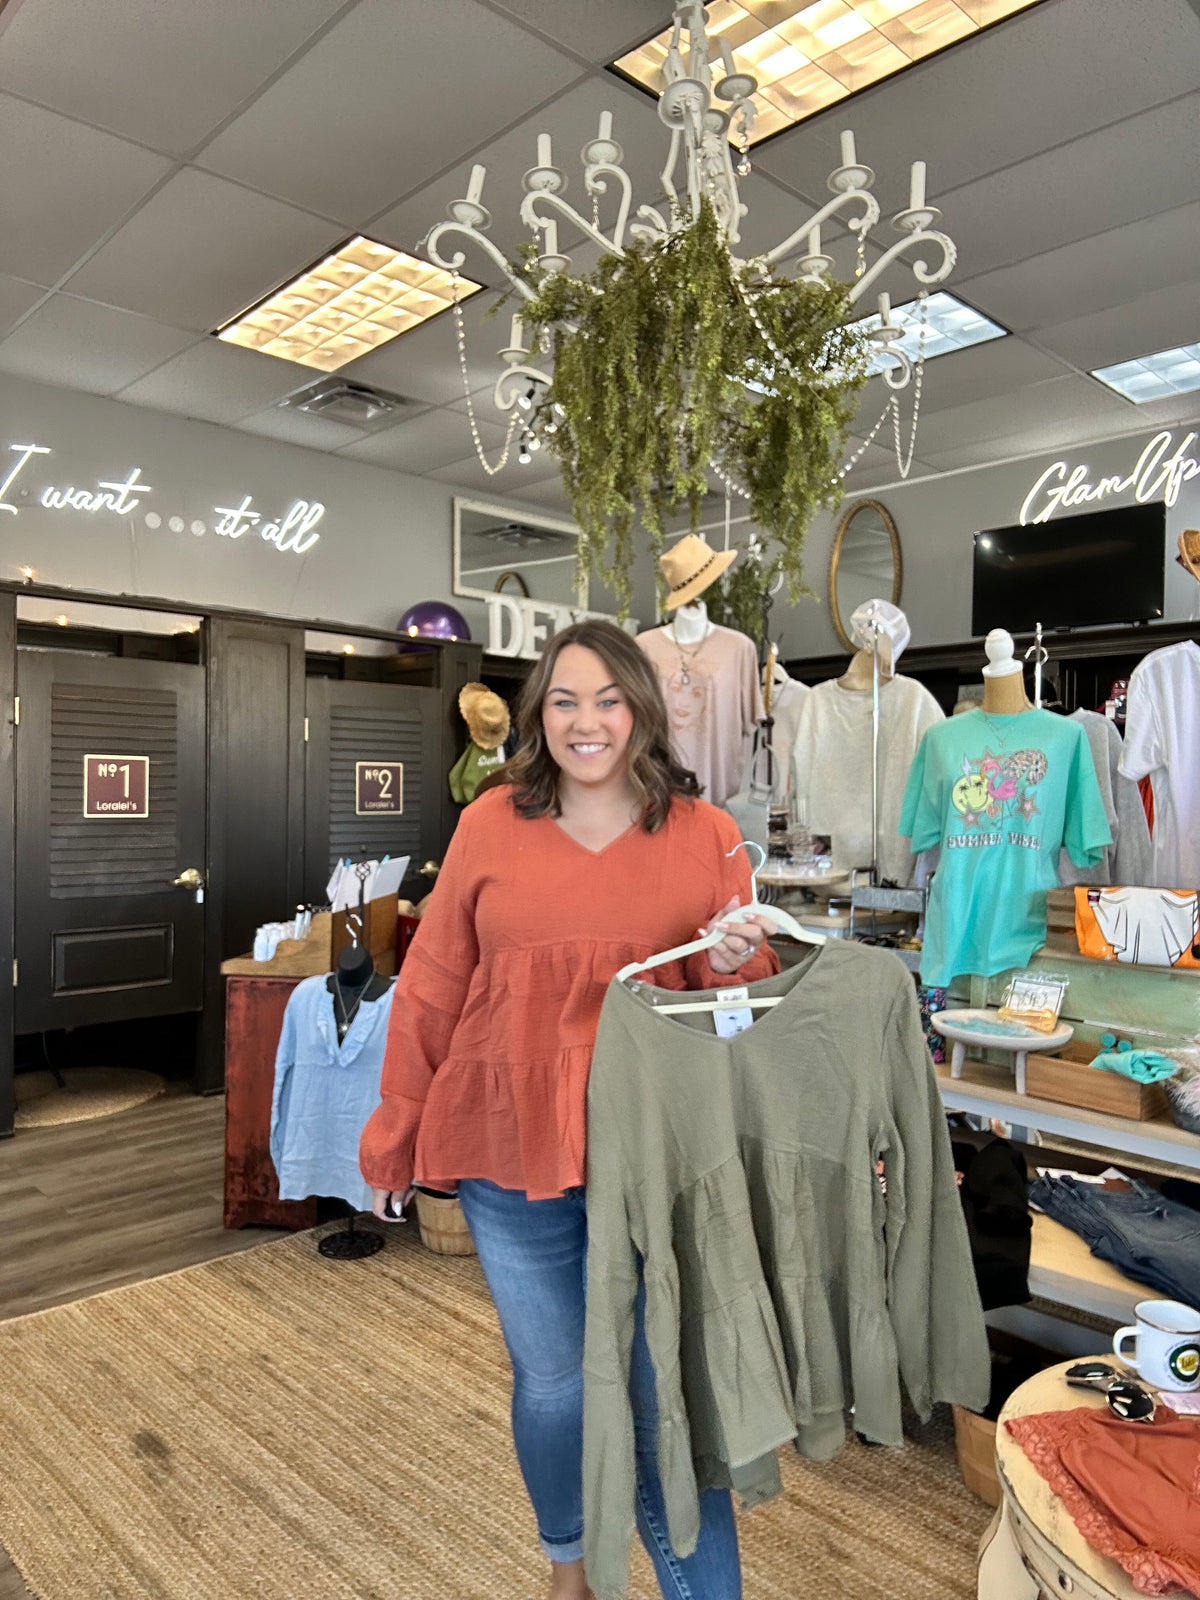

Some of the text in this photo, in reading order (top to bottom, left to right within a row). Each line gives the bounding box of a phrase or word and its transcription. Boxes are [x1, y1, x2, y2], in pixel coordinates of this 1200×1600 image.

[40, 468, 151, 515] want
[214, 495, 260, 539] it
[261, 499, 326, 554] all
[1019, 461, 1133, 526] Glam
[119, 764, 130, 798] 1
[379, 769, 393, 799] 2
